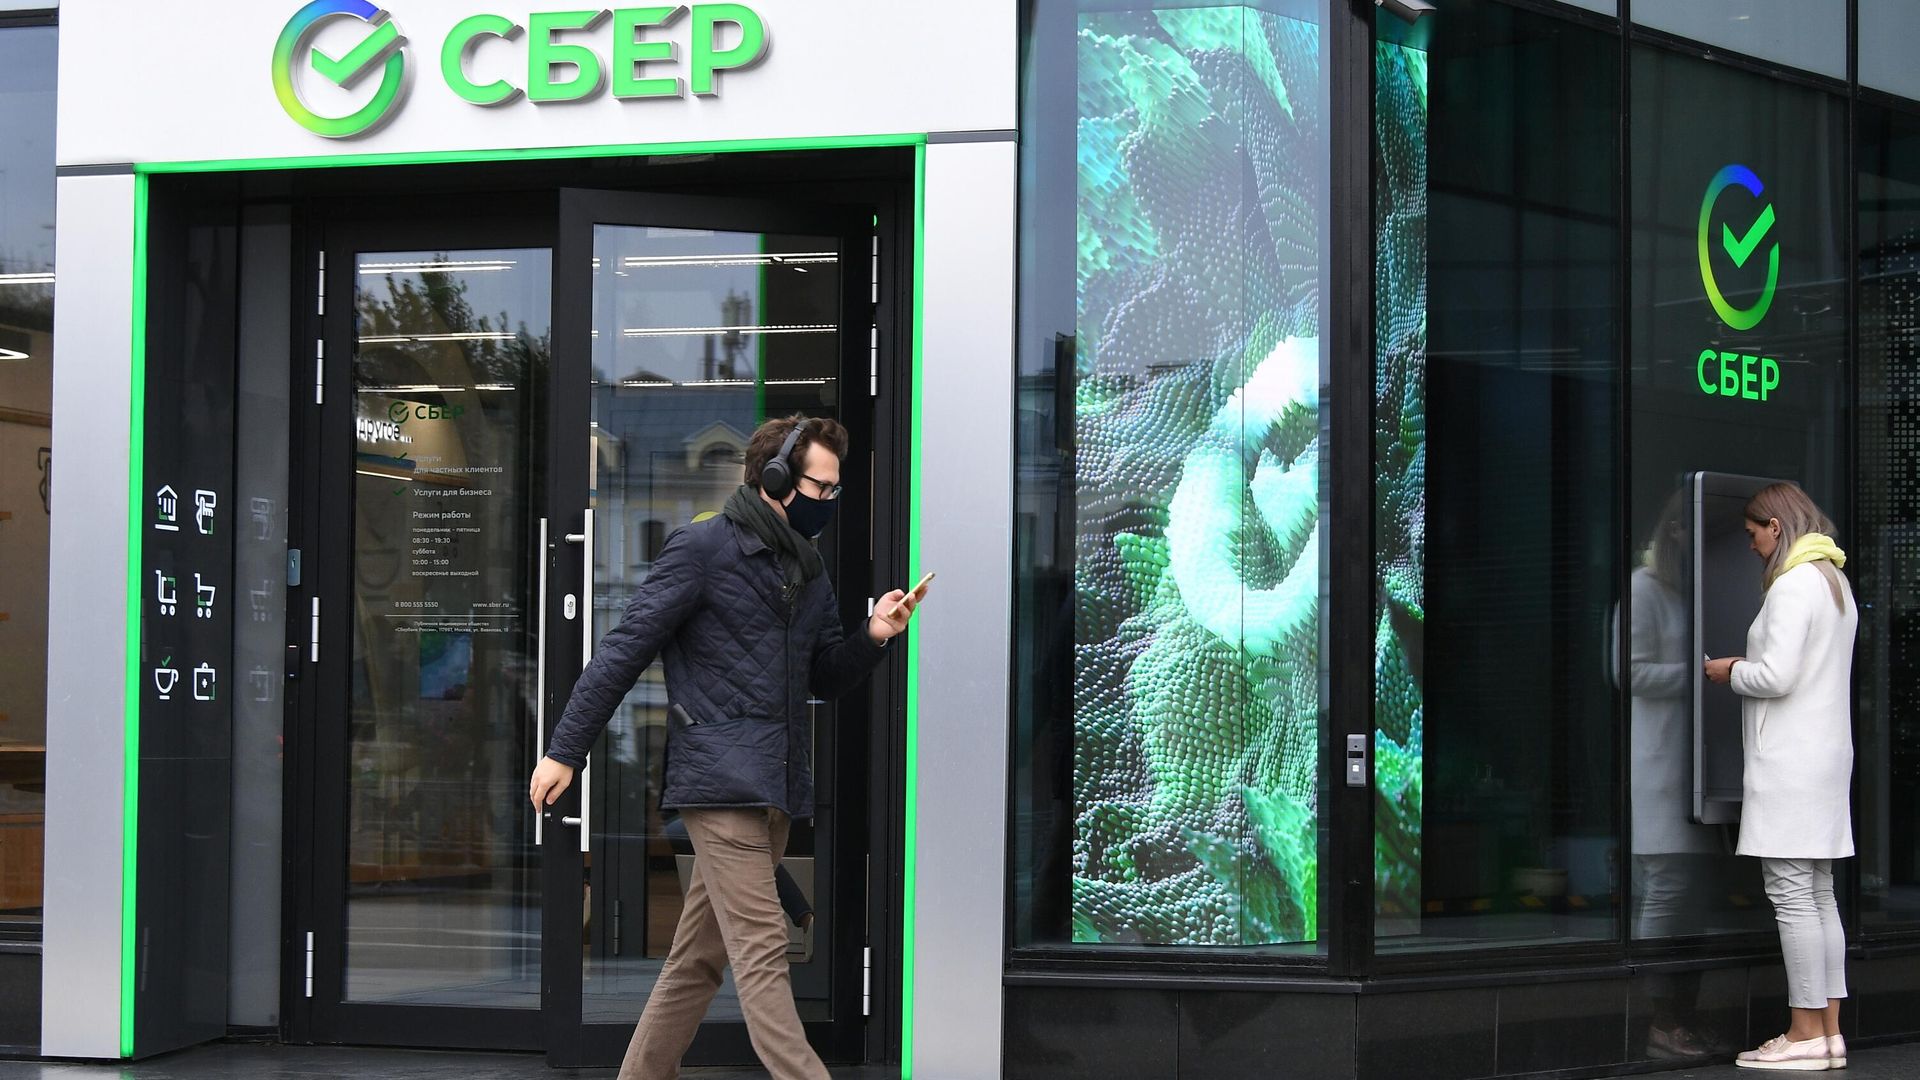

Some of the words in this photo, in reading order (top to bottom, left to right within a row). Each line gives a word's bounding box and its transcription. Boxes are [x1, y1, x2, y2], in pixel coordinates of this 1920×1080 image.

[440, 3, 771, 105] СБЕР
[1697, 349, 1780, 401] СБЕР
[415, 405, 465, 420] СБЕР
[413, 489, 441, 497] Услуги
[459, 487, 492, 496] бизнеса
[412, 511, 440, 519] Режим
[441, 510, 471, 520] работы
